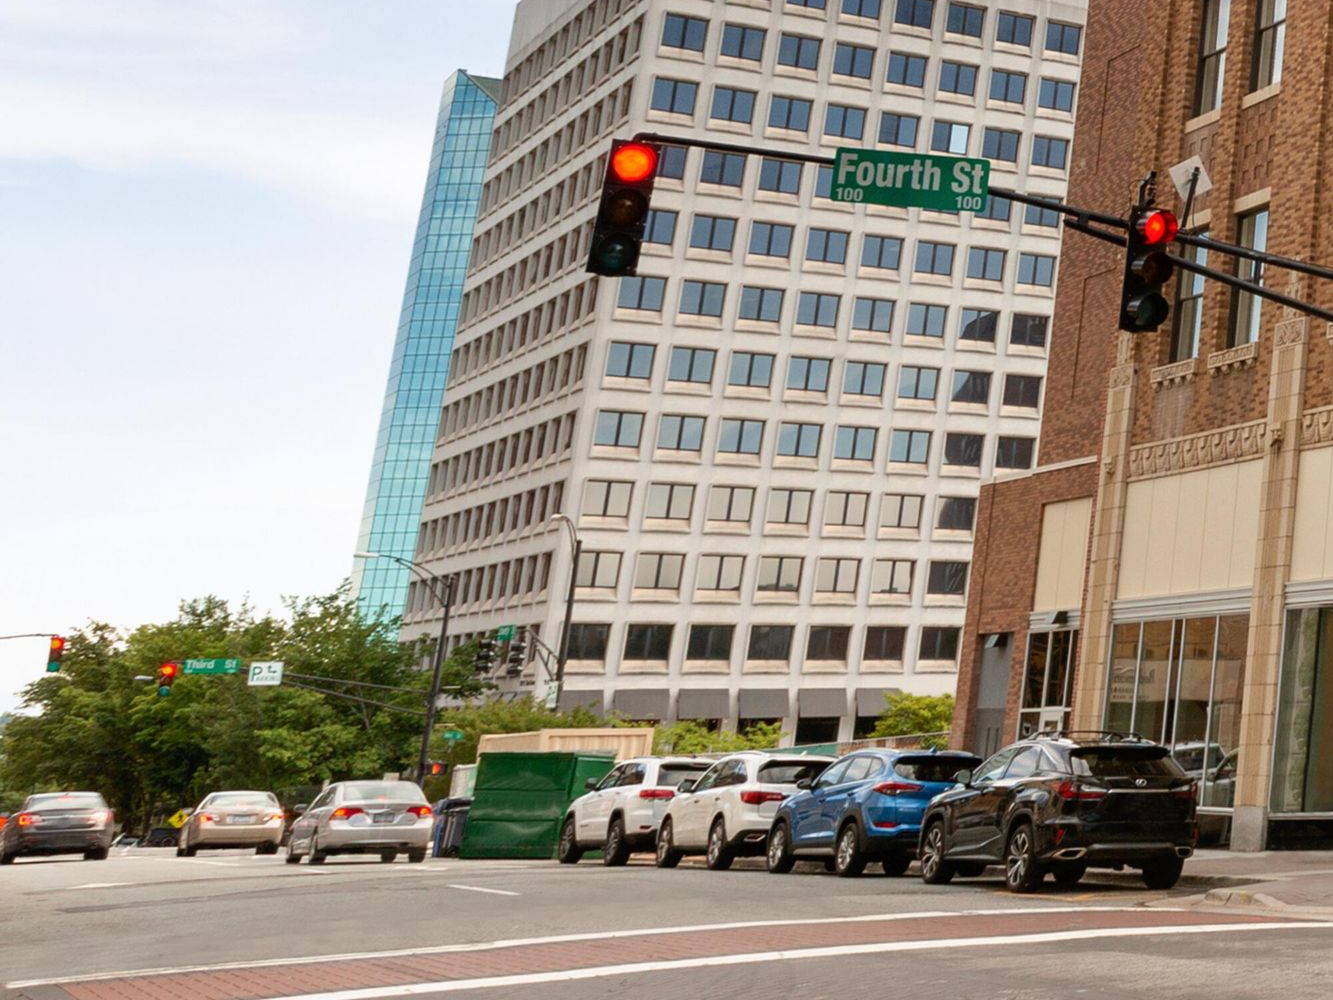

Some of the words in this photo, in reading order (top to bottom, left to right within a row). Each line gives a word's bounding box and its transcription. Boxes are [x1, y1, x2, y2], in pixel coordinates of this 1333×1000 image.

[837, 152, 941, 191] Fourth
[951, 161, 984, 194] St
[836, 187, 864, 201] 100
[955, 196, 981, 210] 100
[187, 659, 216, 669] Third
[224, 660, 237, 668] St
